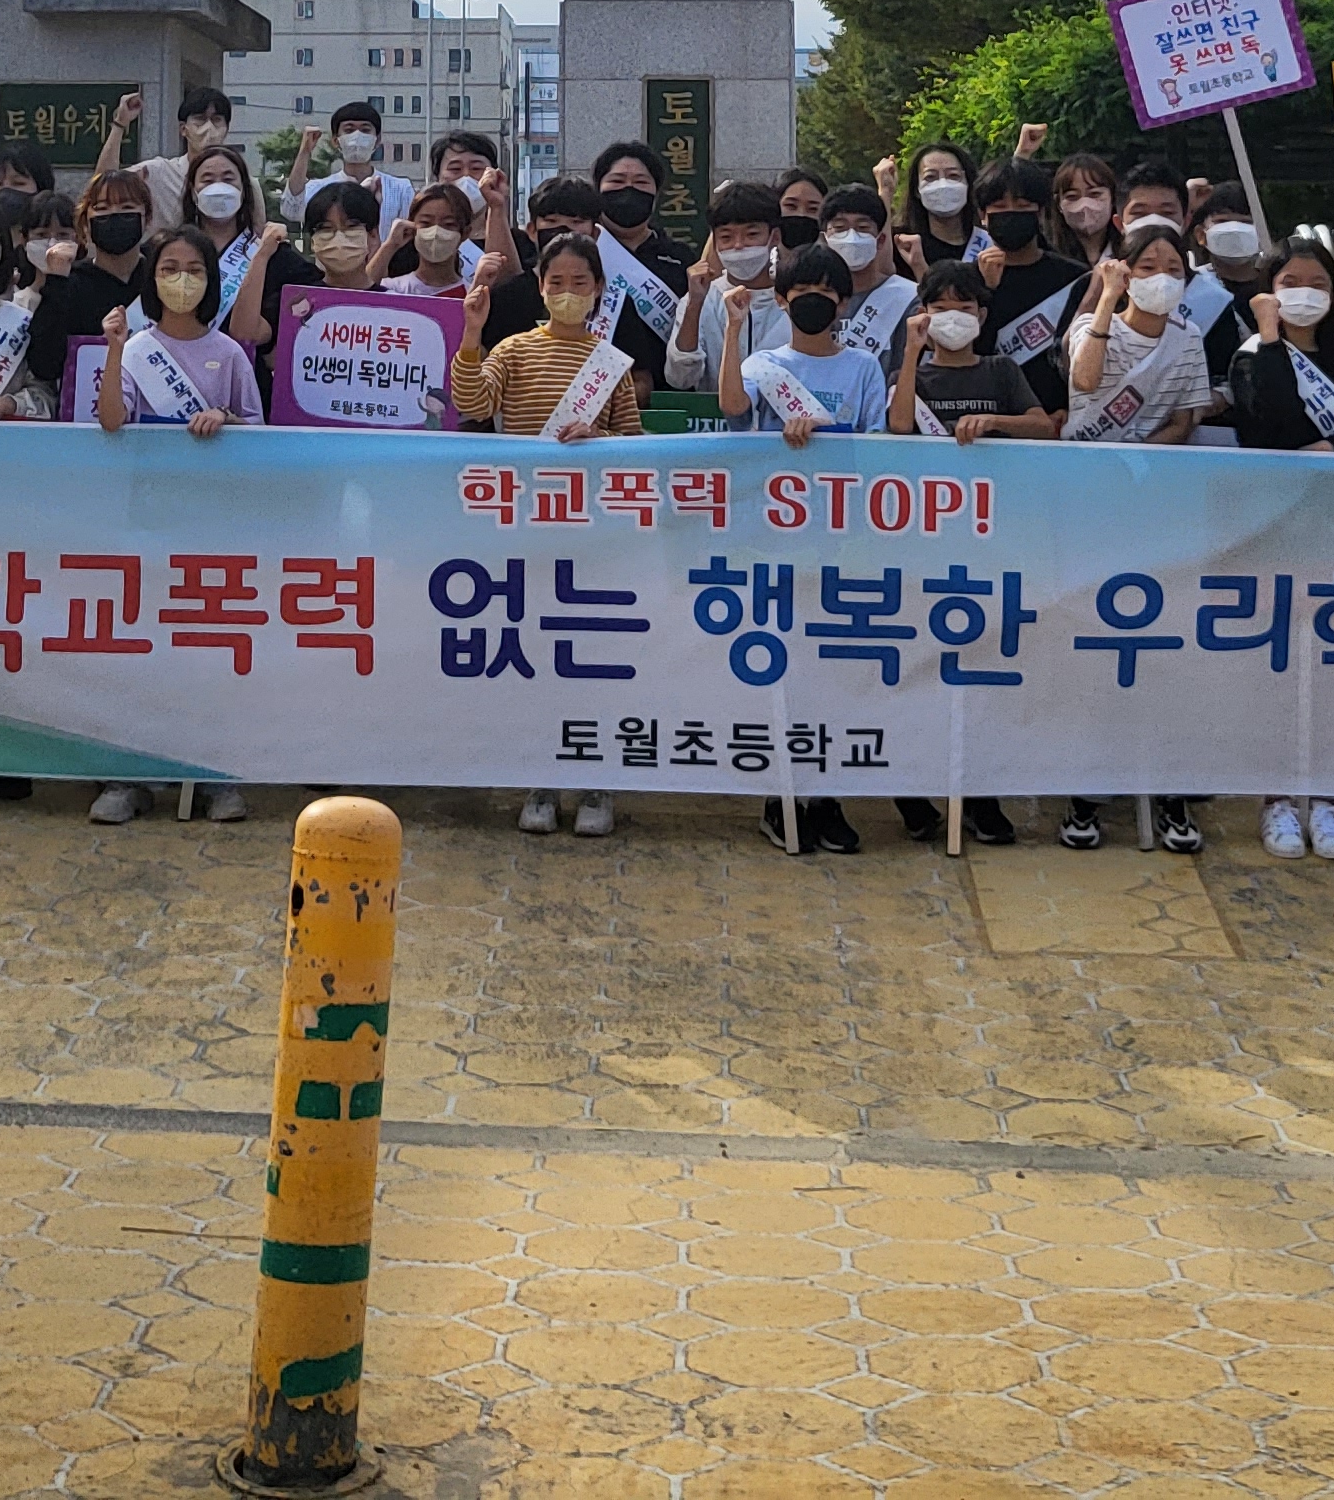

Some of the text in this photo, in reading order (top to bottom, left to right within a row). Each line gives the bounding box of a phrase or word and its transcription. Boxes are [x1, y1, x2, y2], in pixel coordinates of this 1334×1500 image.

[1154, 9, 1261, 55] 잘쓰면 친구
[1169, 34, 1261, 77] 못 쓰면 독
[319, 322, 412, 356] 사이버 중독
[302, 355, 428, 393] 인생의 독입니다
[329, 399, 399, 418] 토월초등학교
[460, 468, 994, 534] 학교폭력 STOP!
[428, 557, 651, 679] 없는
[688, 555, 1037, 686] 행복한
[555, 716, 890, 773] 토월초등학교
